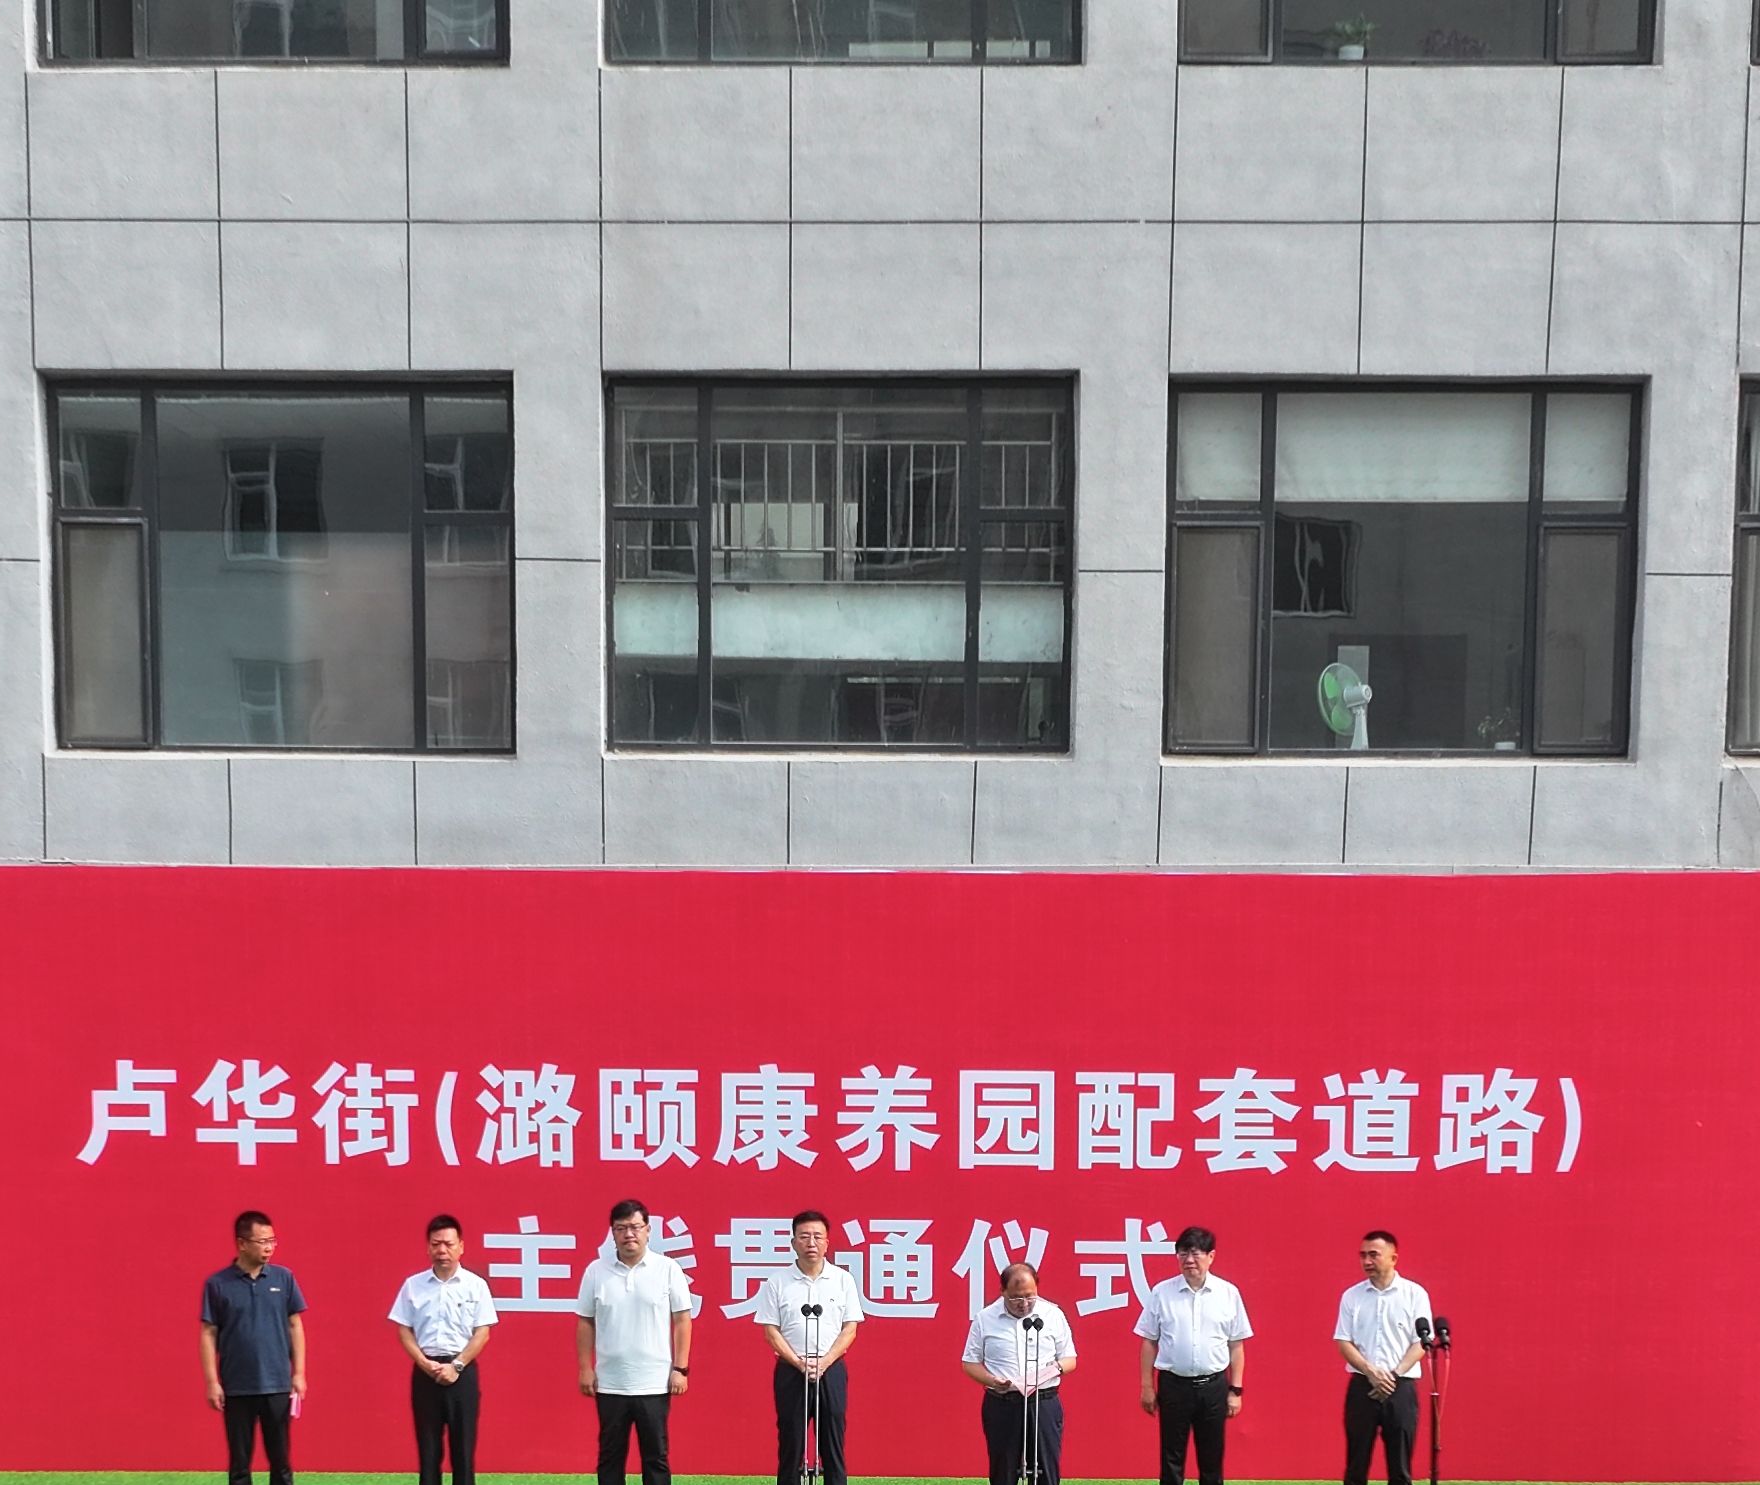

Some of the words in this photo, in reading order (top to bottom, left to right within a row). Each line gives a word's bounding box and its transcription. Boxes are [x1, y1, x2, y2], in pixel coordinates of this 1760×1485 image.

[77, 1060, 1580, 1174] 卢华街(潞颐康养园配套道路)
